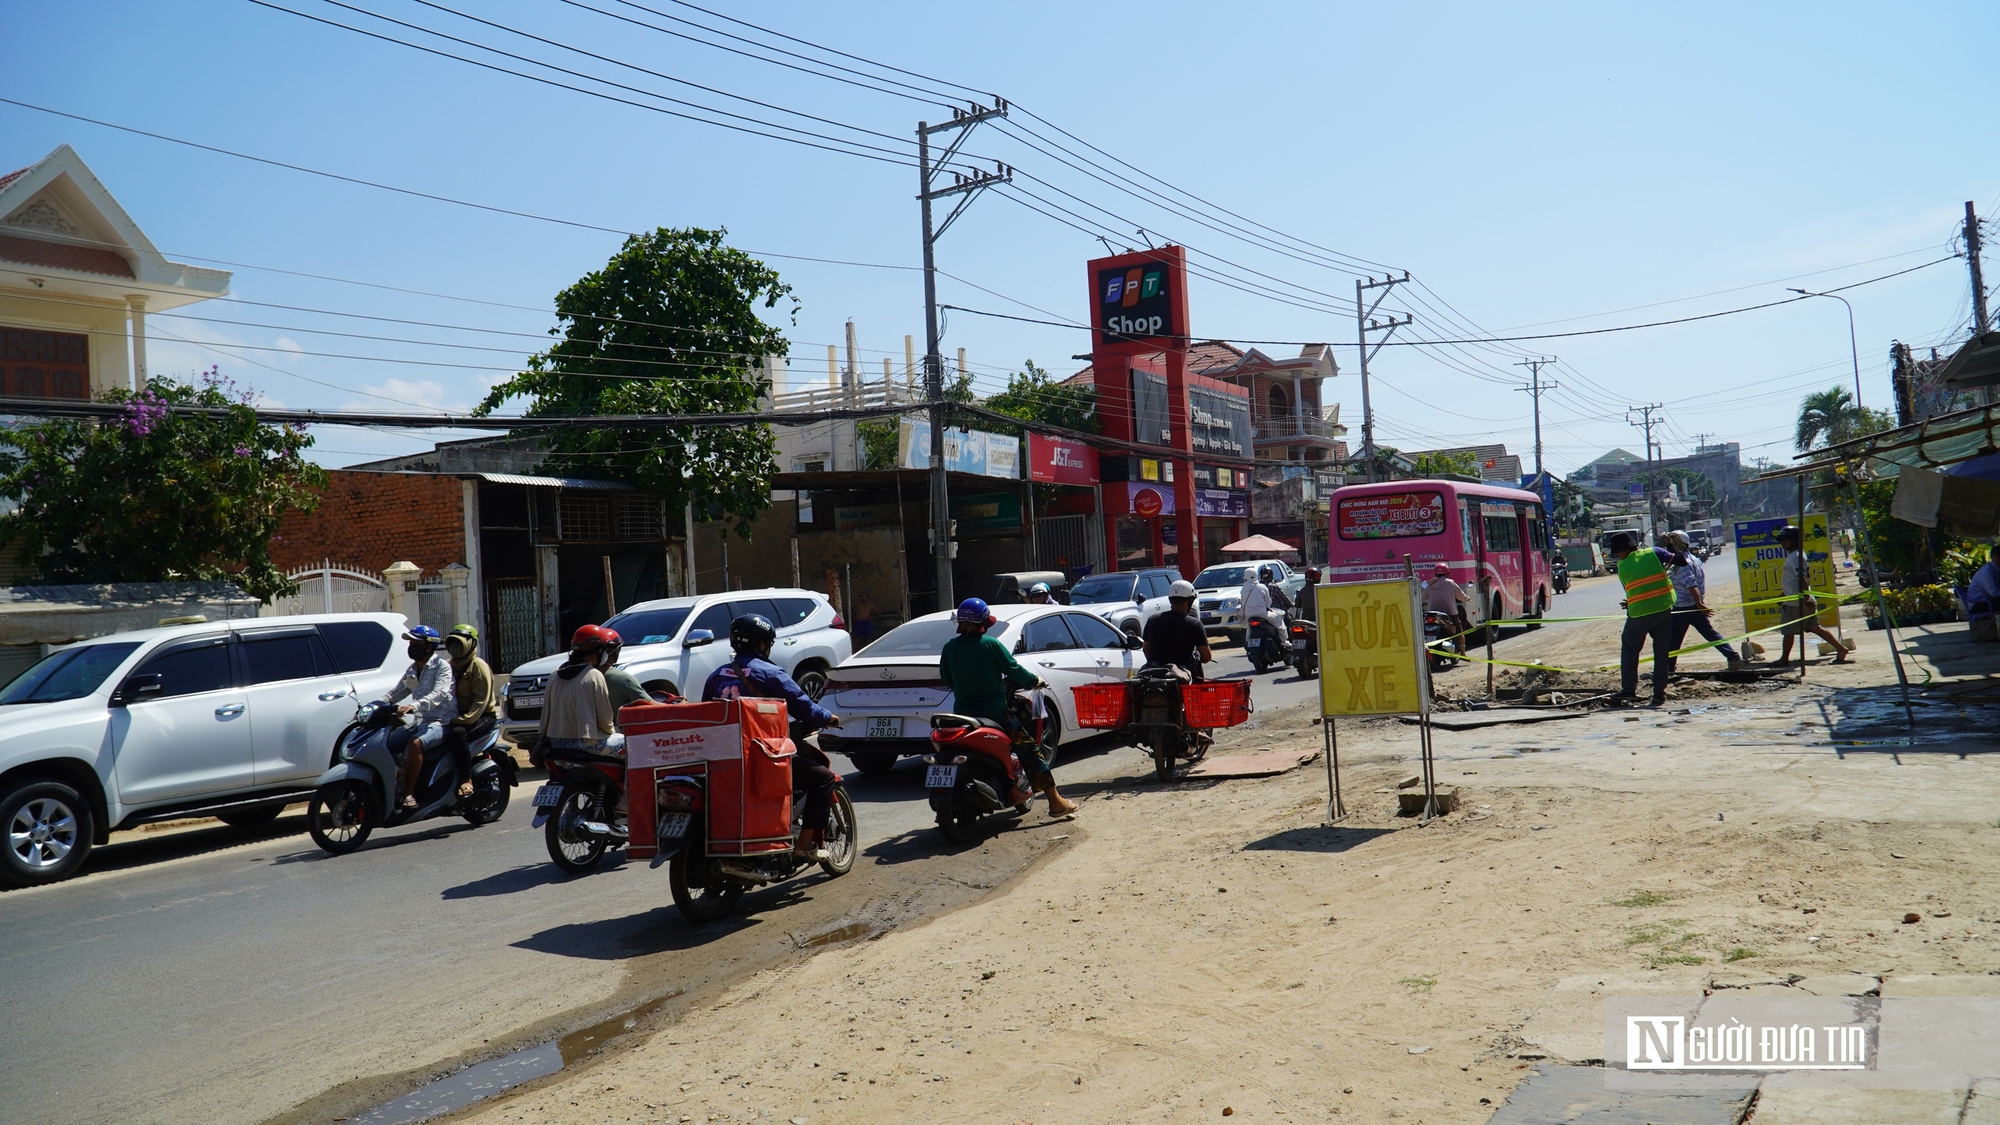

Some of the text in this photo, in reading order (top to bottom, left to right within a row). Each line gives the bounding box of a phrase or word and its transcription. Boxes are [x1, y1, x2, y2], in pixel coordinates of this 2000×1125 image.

[1107, 275, 1158, 298] FPT
[1108, 315, 1162, 335] Shop
[1161, 429, 1171, 444] Điệ
[1192, 437, 1206, 448] aptop
[1050, 447, 1083, 468] J&T EXPRESS
[840, 509, 858, 520] Rửa
[1390, 509, 1399, 520] XE
[1401, 505, 1418, 520] BUÝT
[1756, 547, 1787, 560] HON
[1747, 563, 1828, 592] HÙG
[1323, 591, 1409, 652] RỬA
[1345, 666, 1398, 711] XE
[876, 718, 891, 727] 86A
[870, 728, 897, 737] 278.03
[652, 734, 705, 747] Yakult
[931, 766, 952, 776] 86-AA
[927, 776, 954, 786] 230.21
[659, 824, 684, 836] 8717
